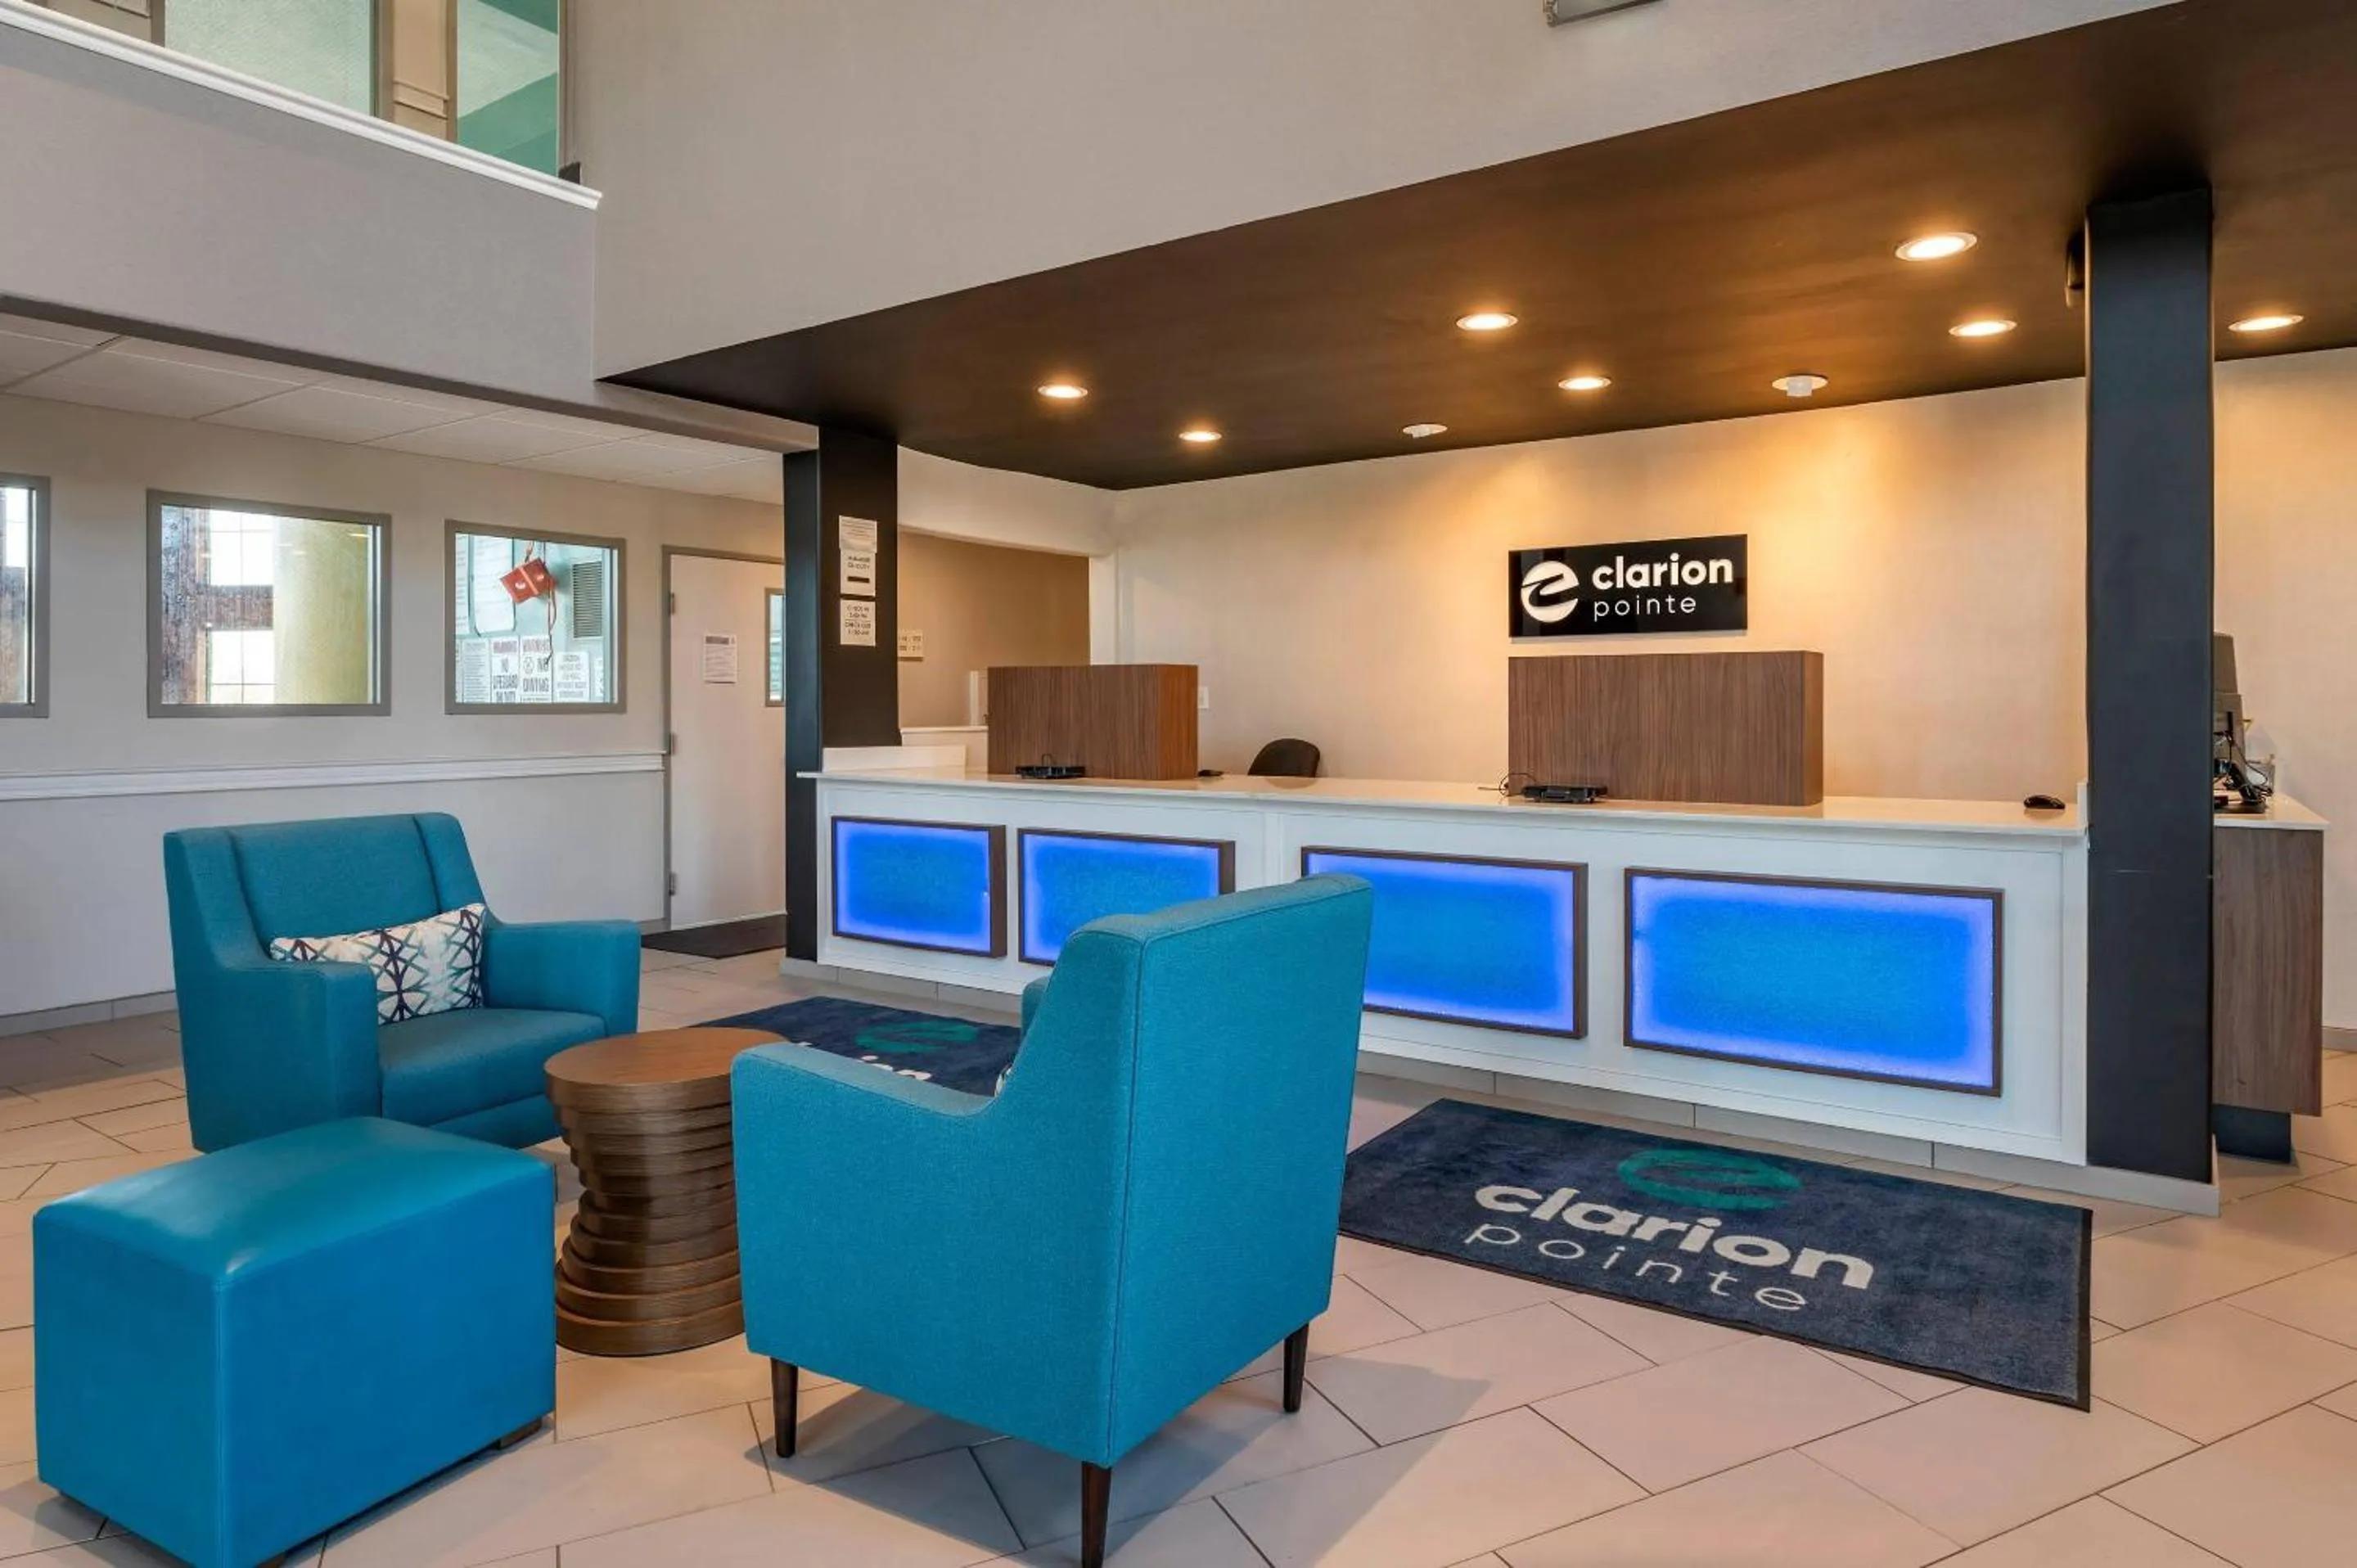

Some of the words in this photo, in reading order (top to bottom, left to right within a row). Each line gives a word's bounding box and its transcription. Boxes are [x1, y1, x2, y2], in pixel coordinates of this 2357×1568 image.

[1592, 552, 1733, 590] clarion
[1593, 595, 1697, 622] pointe
[1464, 1223, 1807, 1310] pointe
[1475, 1185, 1874, 1289] clarion
